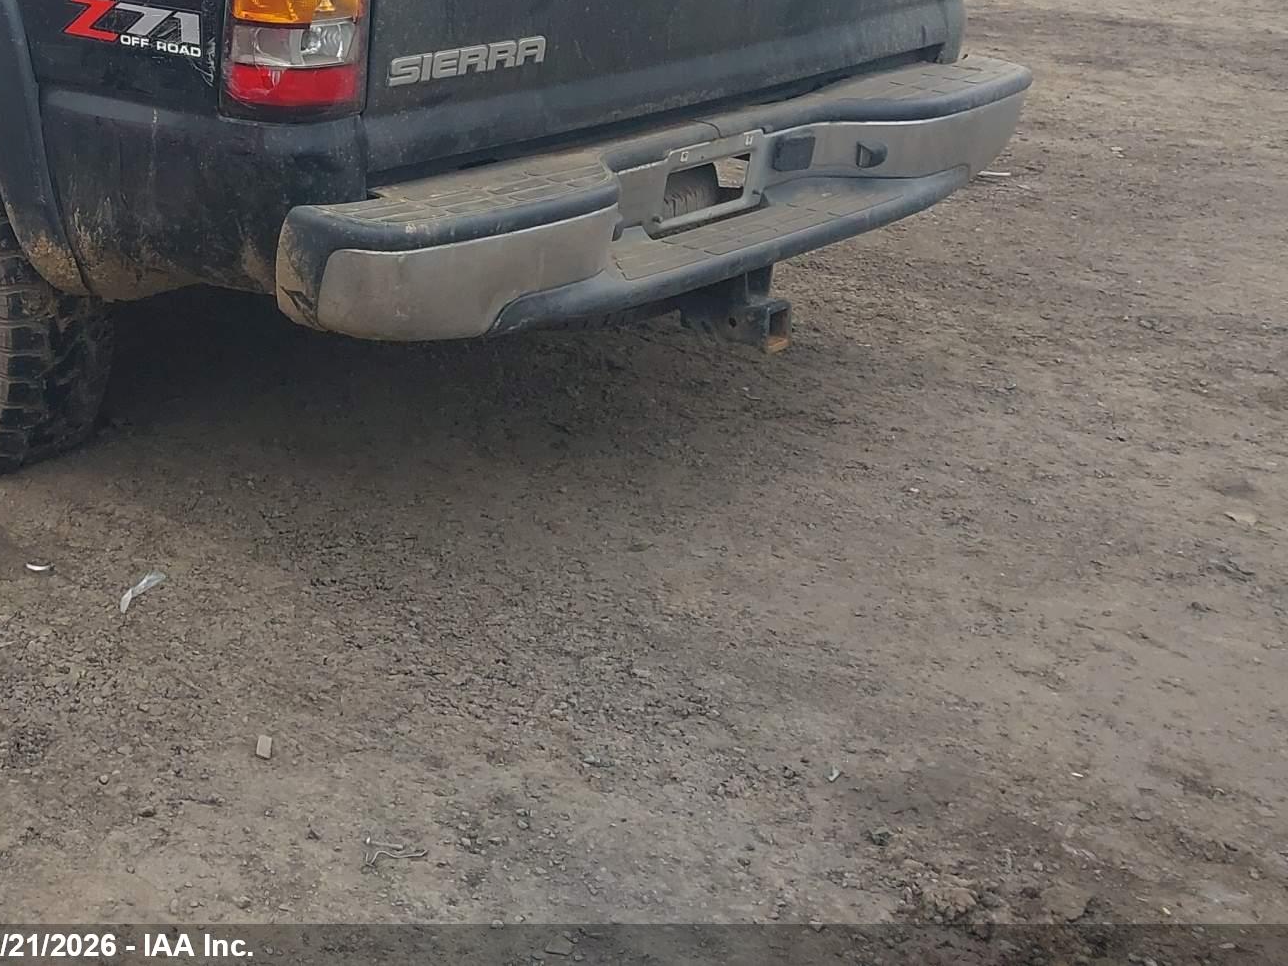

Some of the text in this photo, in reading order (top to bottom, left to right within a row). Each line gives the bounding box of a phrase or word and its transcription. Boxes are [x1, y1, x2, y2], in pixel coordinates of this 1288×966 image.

[119, 34, 202, 58] OFF ROAD
[388, 35, 547, 87] SIERRA
